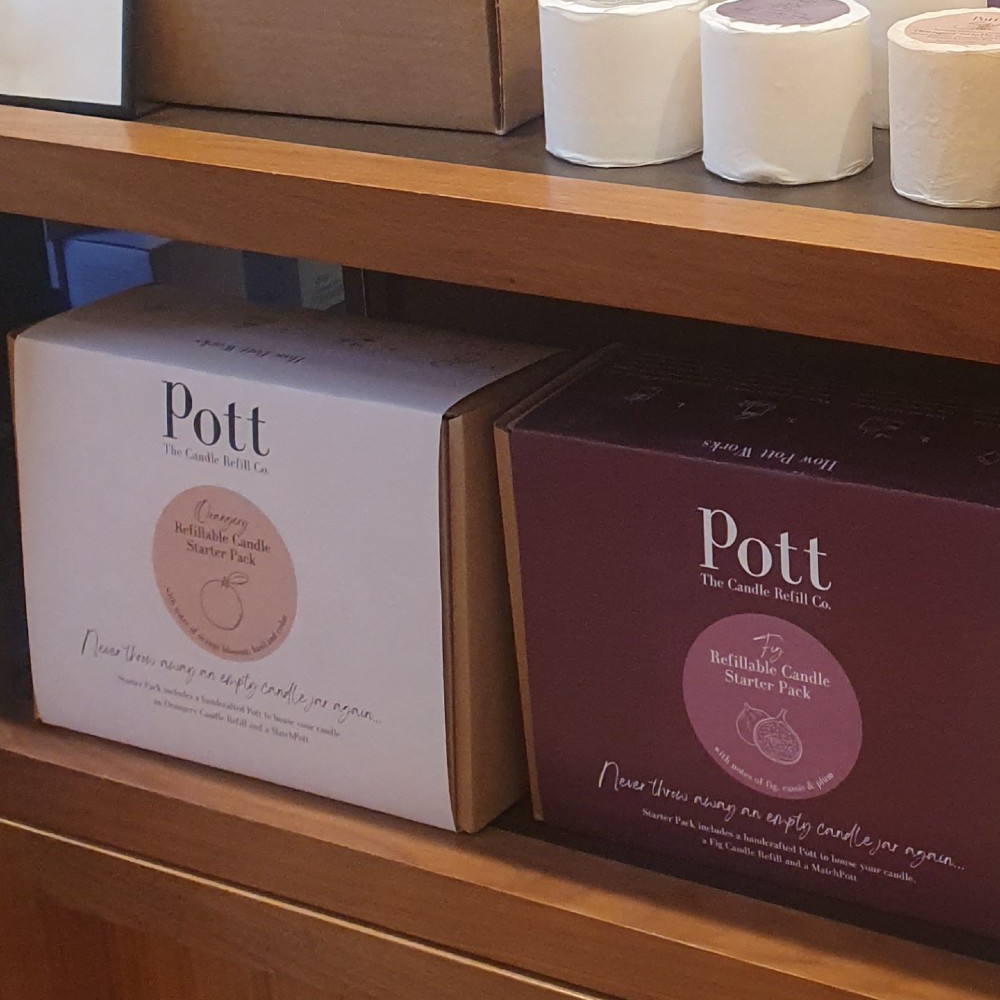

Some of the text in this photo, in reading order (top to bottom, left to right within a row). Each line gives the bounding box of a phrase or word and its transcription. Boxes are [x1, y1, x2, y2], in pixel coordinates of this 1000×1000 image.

[162, 380, 270, 456] Pott
[164, 443, 270, 475] The Candle Refill Co.
[702, 440, 838, 472] How Pott Works
[175, 521, 270, 553] Refillable Candle
[697, 507, 832, 591] Pott
[187, 541, 255, 566] Starter Pack
[701, 573, 831, 610] The Candle Refill Co.
[753, 633, 784, 663] Fig
[710, 649, 831, 688] Refillable Candle
[725, 670, 811, 700] Starter Pack
[599, 761, 965, 870] Never throw away an empty candle jar again...
